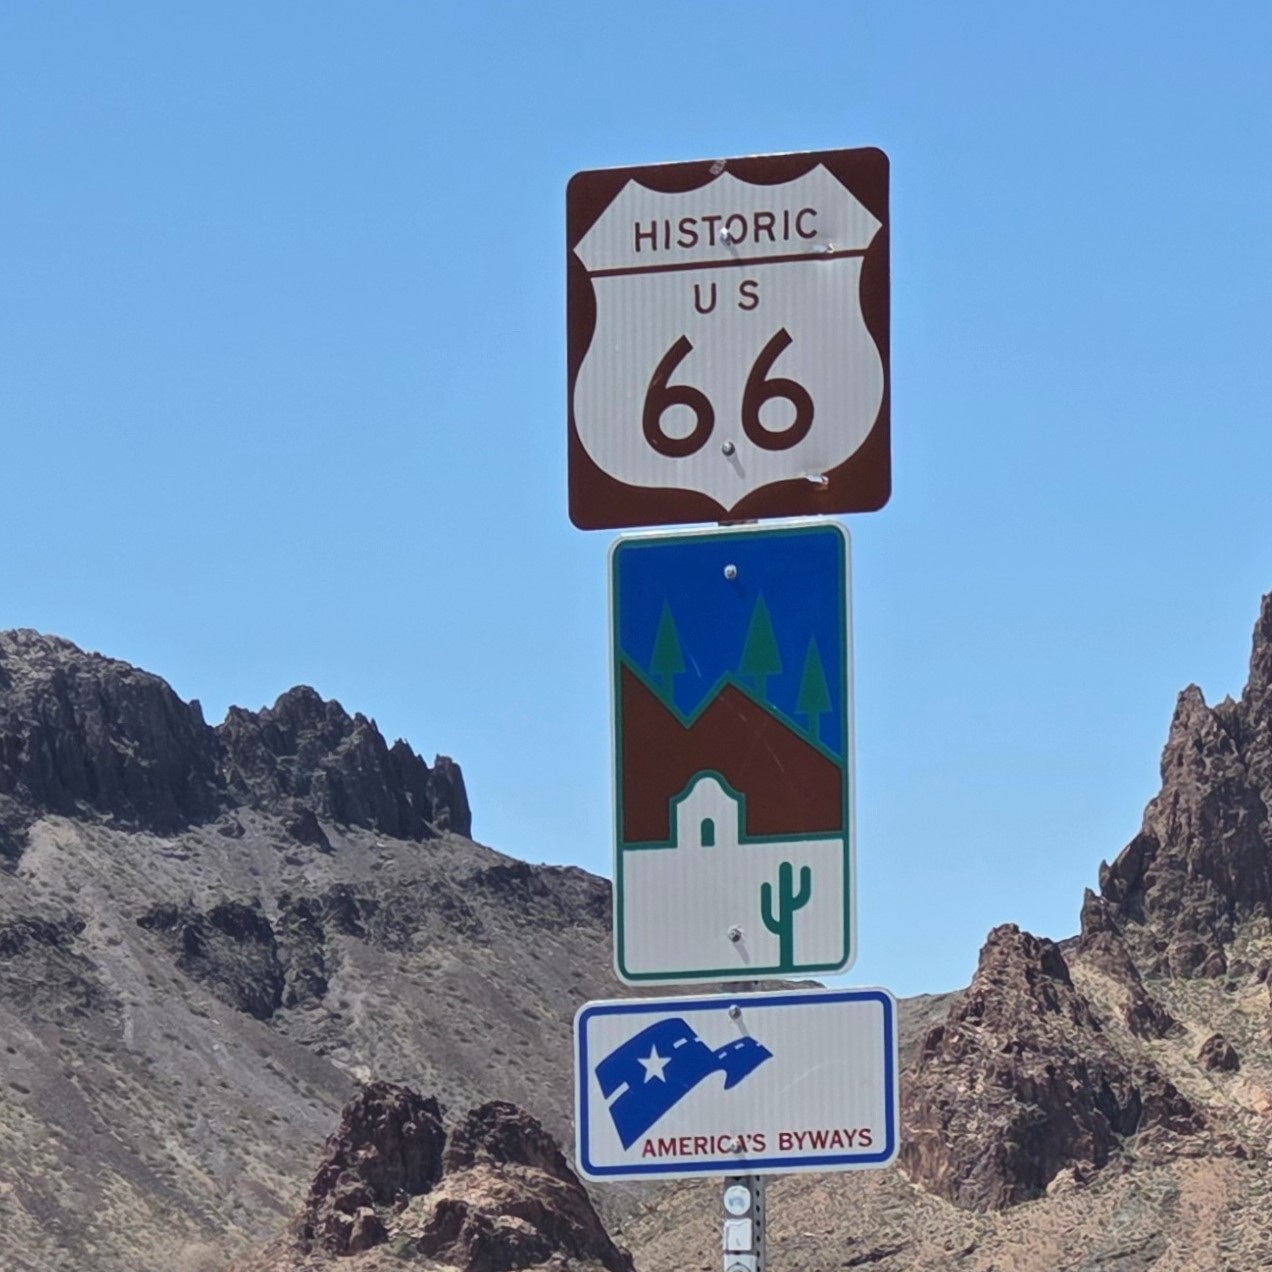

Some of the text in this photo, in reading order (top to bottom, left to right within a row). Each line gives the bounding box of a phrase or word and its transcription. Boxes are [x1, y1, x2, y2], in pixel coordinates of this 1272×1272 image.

[634, 207, 818, 252] HISTORIC
[642, 326, 815, 459] 66
[641, 1127, 874, 1158] AMERICA'S BYWAYS
